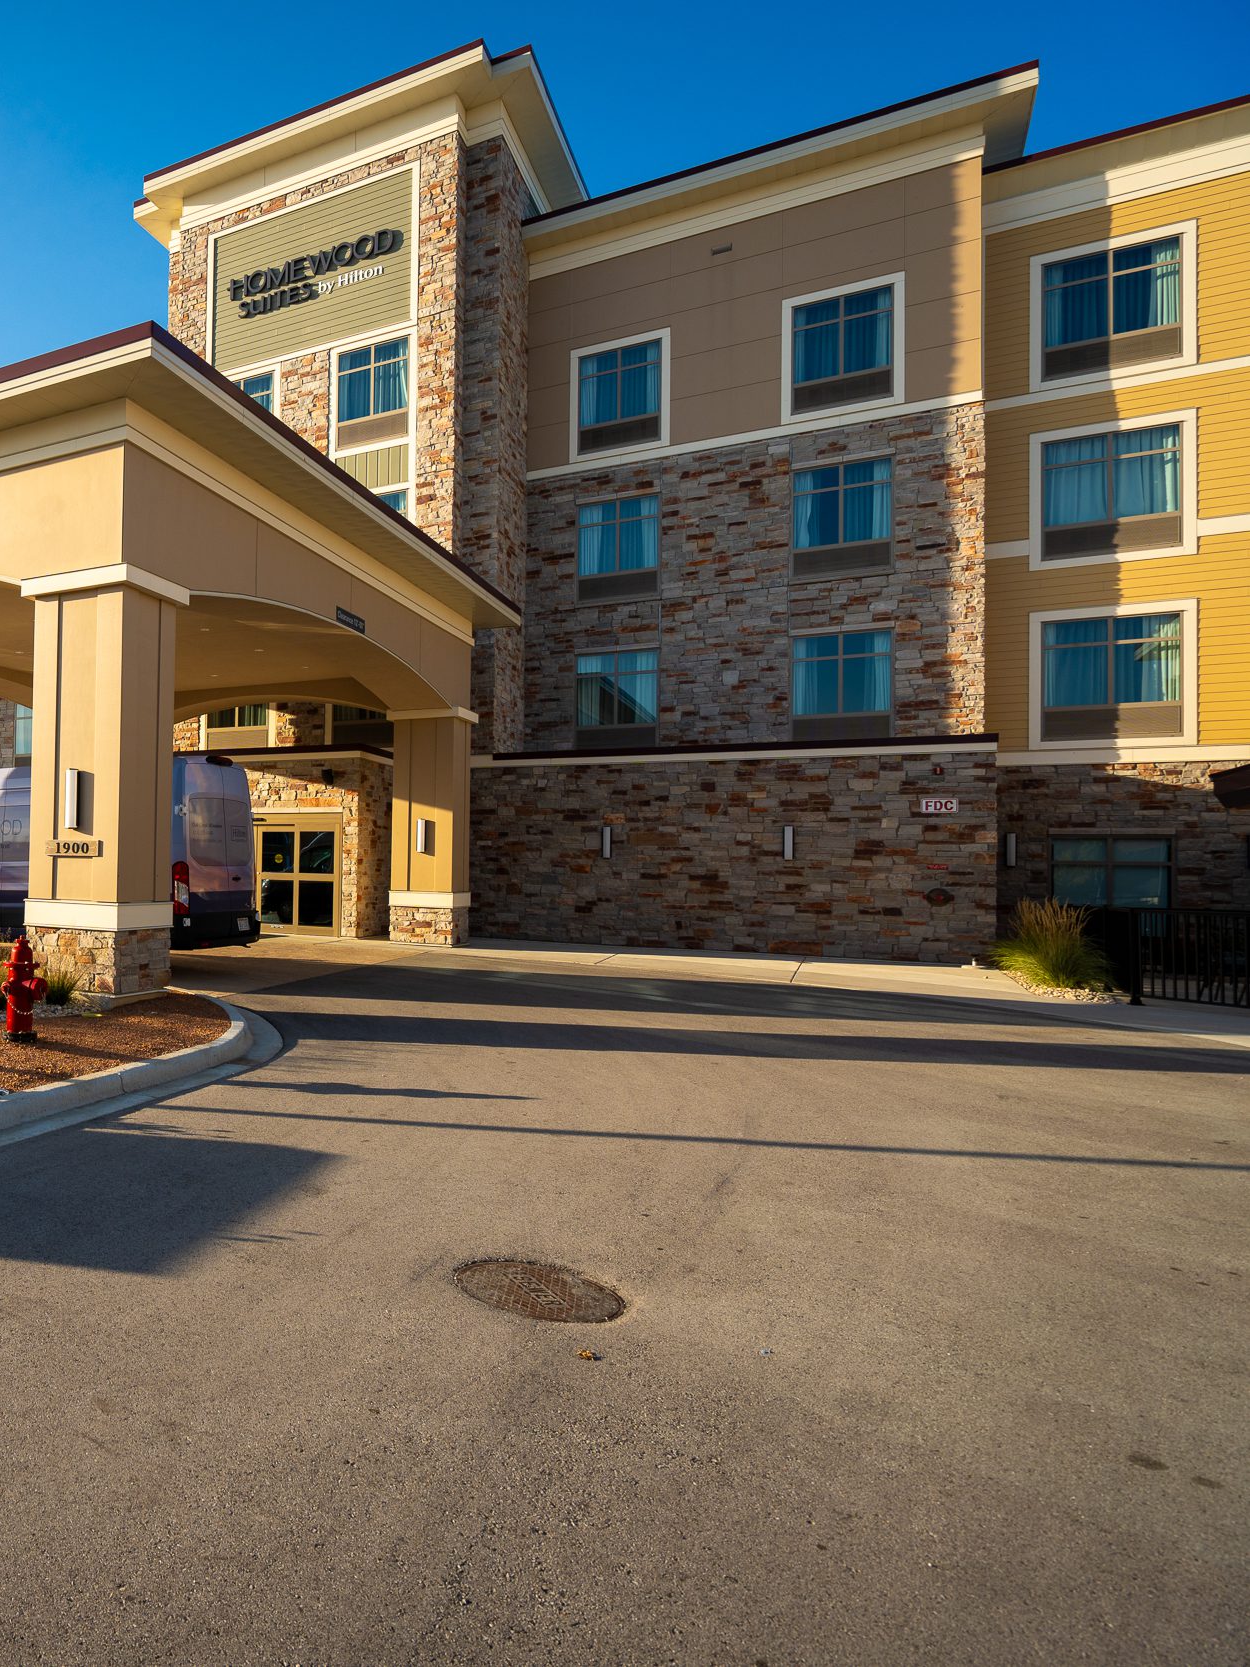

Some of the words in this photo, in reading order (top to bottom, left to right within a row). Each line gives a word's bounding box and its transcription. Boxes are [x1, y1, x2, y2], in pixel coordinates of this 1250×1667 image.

[227, 228, 394, 301] HOMEWOOD
[238, 282, 312, 319] SUITES
[317, 281, 335, 294] by
[337, 265, 384, 287] Hilton
[925, 800, 954, 811] FDC
[55, 842, 90, 854] 1900
[511, 1274, 564, 1308] SEWER
